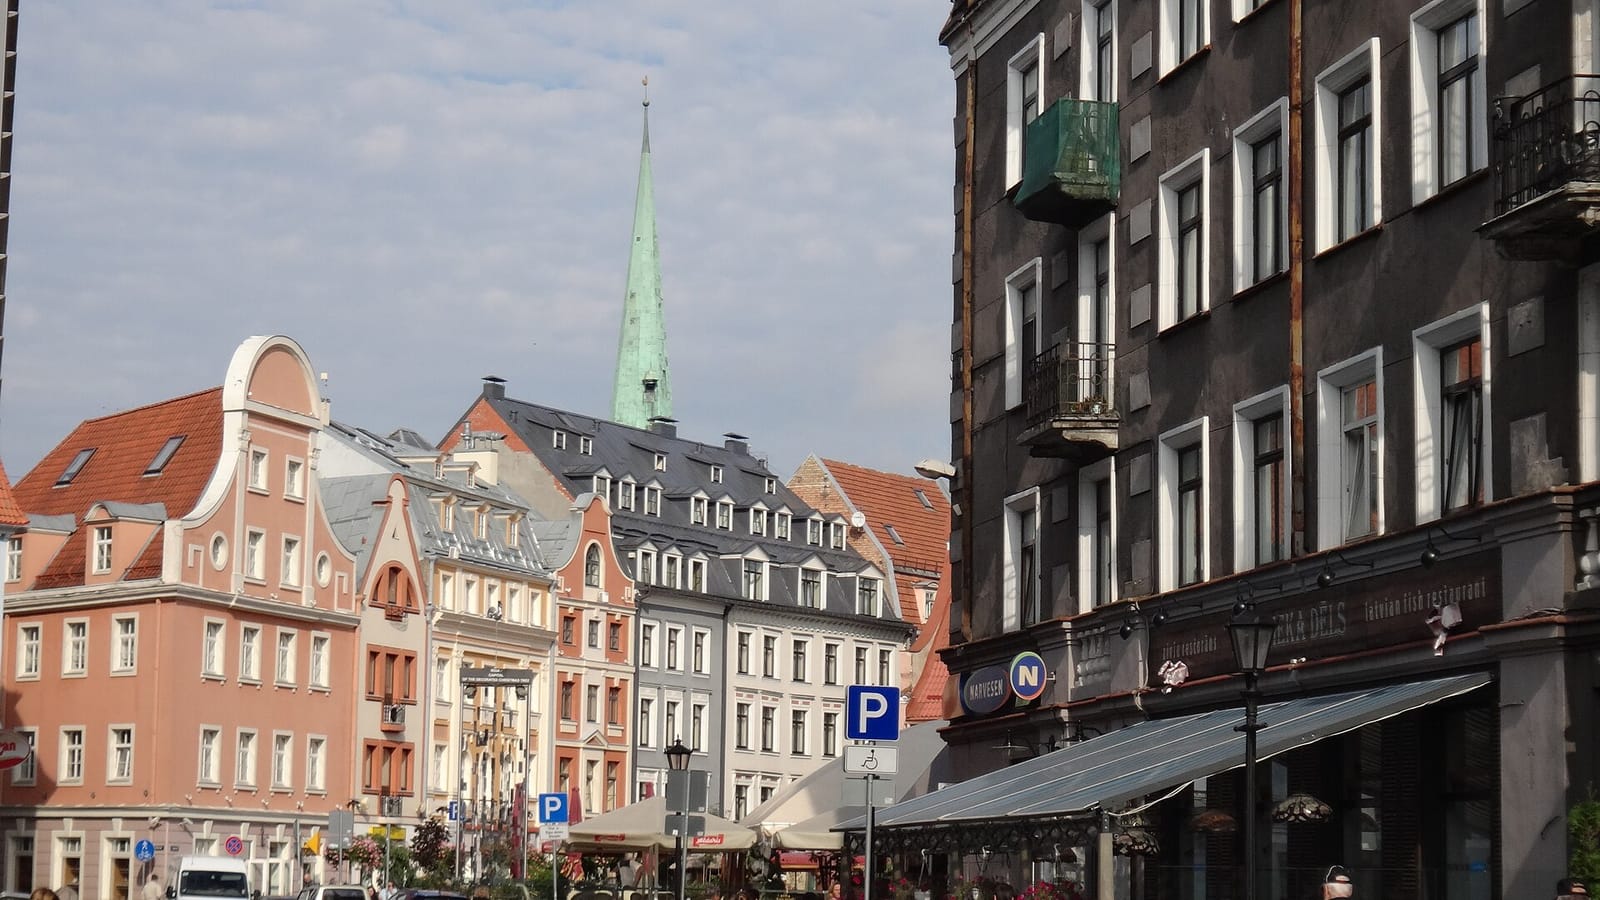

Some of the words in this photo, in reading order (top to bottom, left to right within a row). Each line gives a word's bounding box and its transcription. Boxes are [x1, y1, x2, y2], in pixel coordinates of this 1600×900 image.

[1364, 598, 1399, 621] latvian
[1402, 589, 1422, 614] fish
[1426, 577, 1486, 608] restaurant
[1310, 600, 1345, 640] DĒLS
[970, 679, 1003, 701] NARVESEN
[1018, 665, 1038, 687] N
[859, 692, 888, 733] P
[545, 796, 562, 820] P
